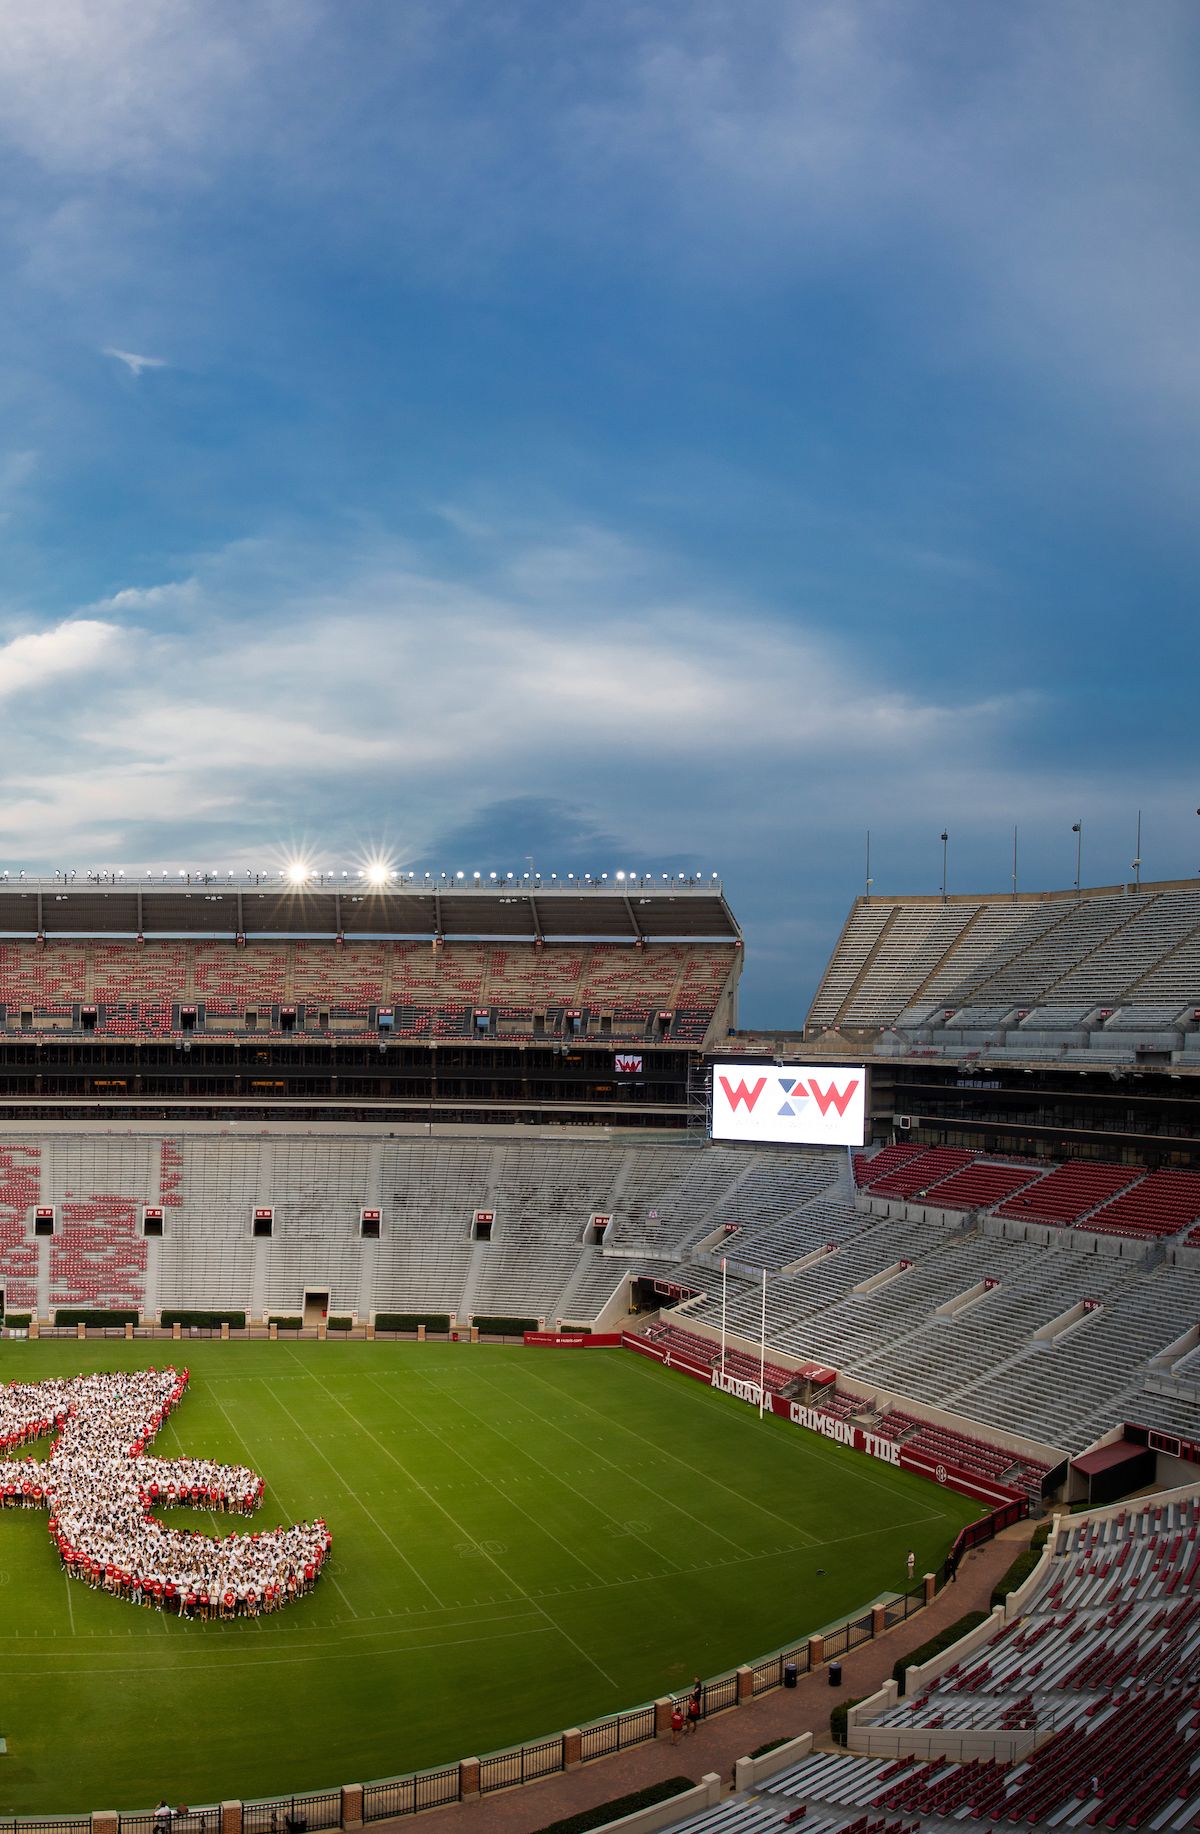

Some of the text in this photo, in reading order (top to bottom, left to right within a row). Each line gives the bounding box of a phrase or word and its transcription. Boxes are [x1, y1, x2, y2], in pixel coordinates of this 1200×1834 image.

[711, 1369, 774, 1413] ALABAMA
[789, 1402, 901, 1467] CRIMSON TIDE
